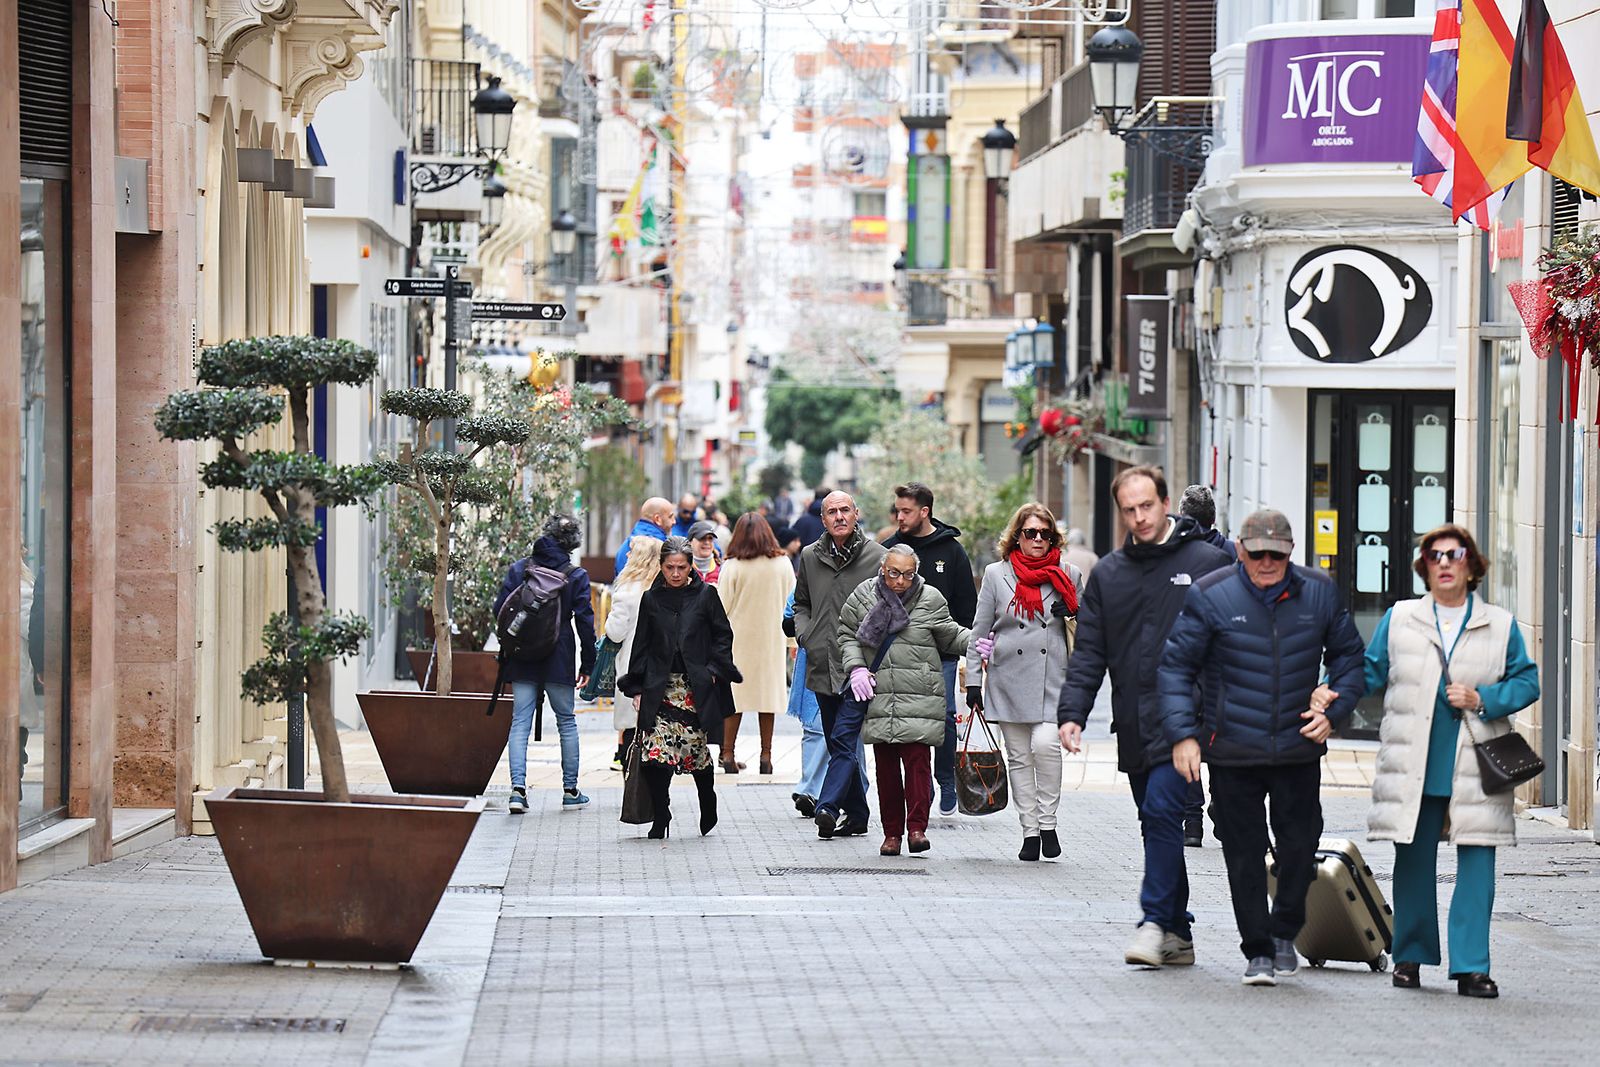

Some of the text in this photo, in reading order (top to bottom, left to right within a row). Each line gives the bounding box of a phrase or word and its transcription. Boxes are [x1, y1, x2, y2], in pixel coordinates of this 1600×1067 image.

[1318, 125, 1347, 135] ORTIZ
[1311, 137, 1354, 146] ABOGADOS
[500, 304, 533, 312] Concepción
[1138, 318, 1157, 395] TIGER
